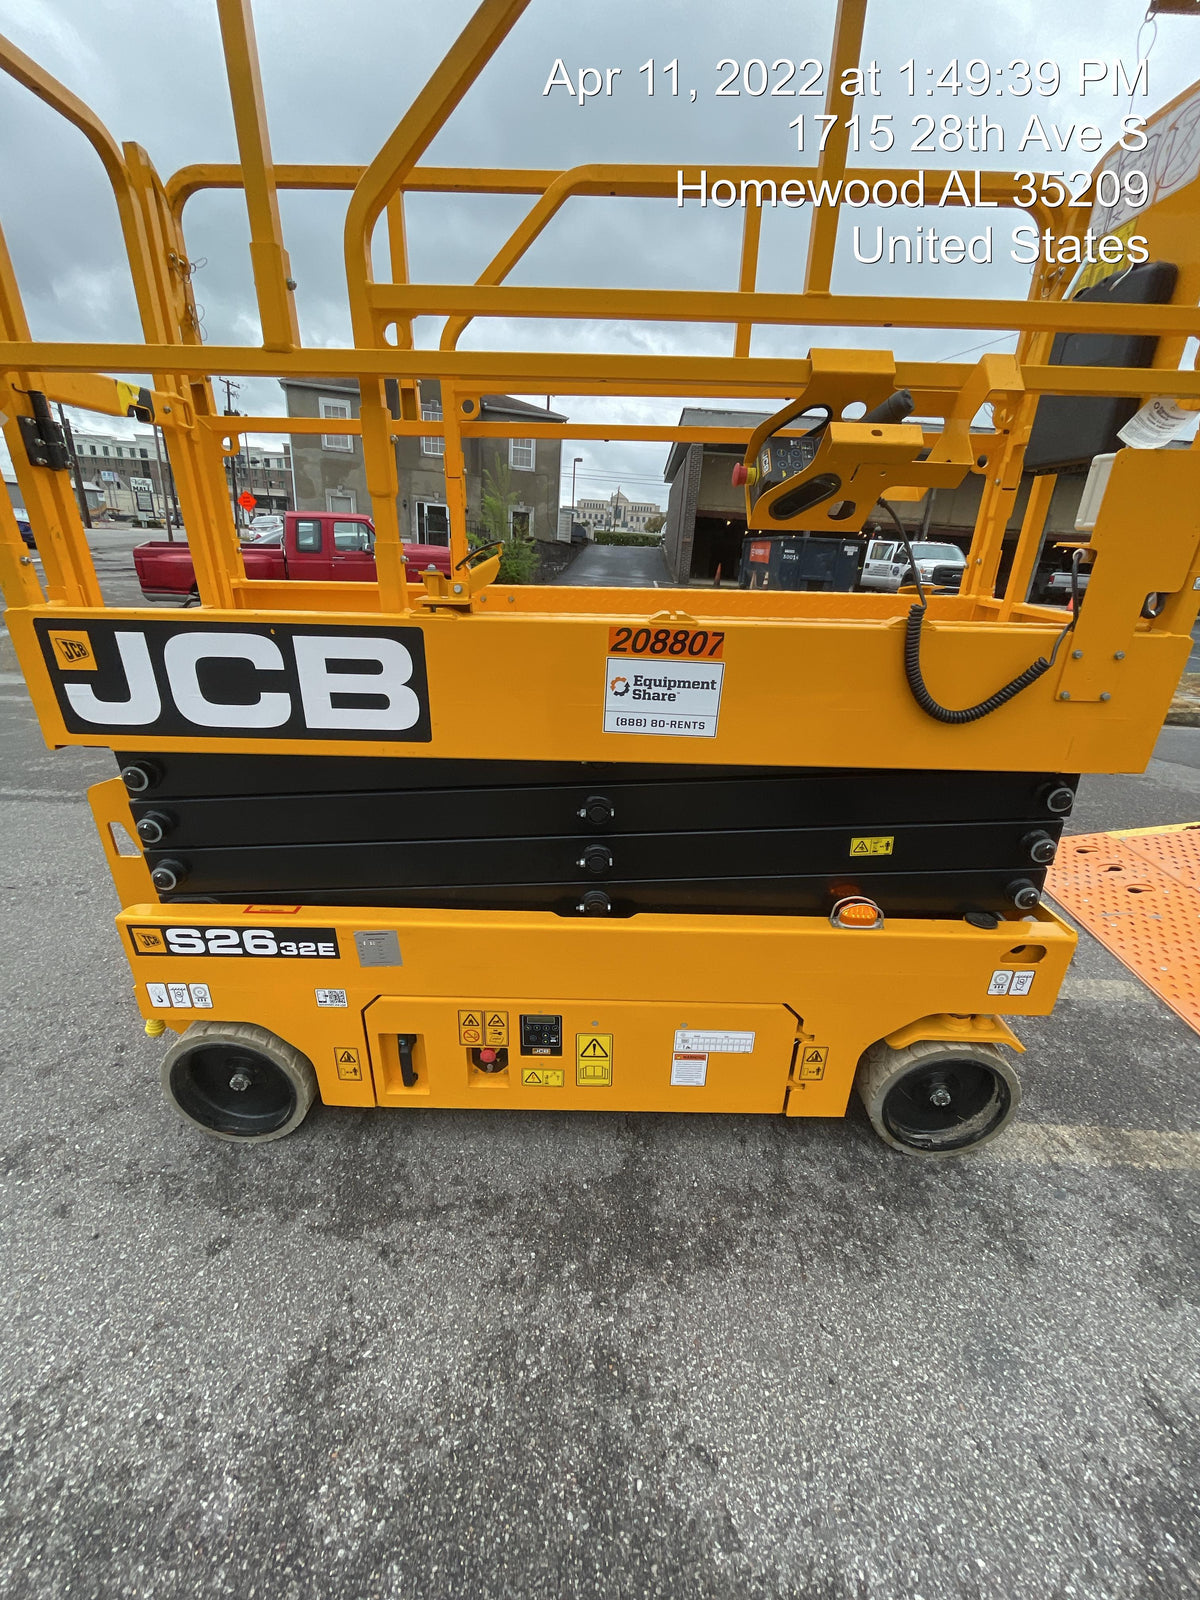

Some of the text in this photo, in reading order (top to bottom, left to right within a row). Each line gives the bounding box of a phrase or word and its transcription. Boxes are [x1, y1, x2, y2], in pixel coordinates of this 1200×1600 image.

[62, 638, 88, 661] JCB
[610, 627, 725, 656] 208807
[64, 631, 420, 731] JCB
[633, 675, 717, 691] Equipment
[632, 688, 677, 702] Share
[616, 716, 706, 730] (888) 80-RENTS
[142, 933, 161, 947] JCB
[165, 928, 278, 956] S26
[280, 941, 336, 956] 32E
